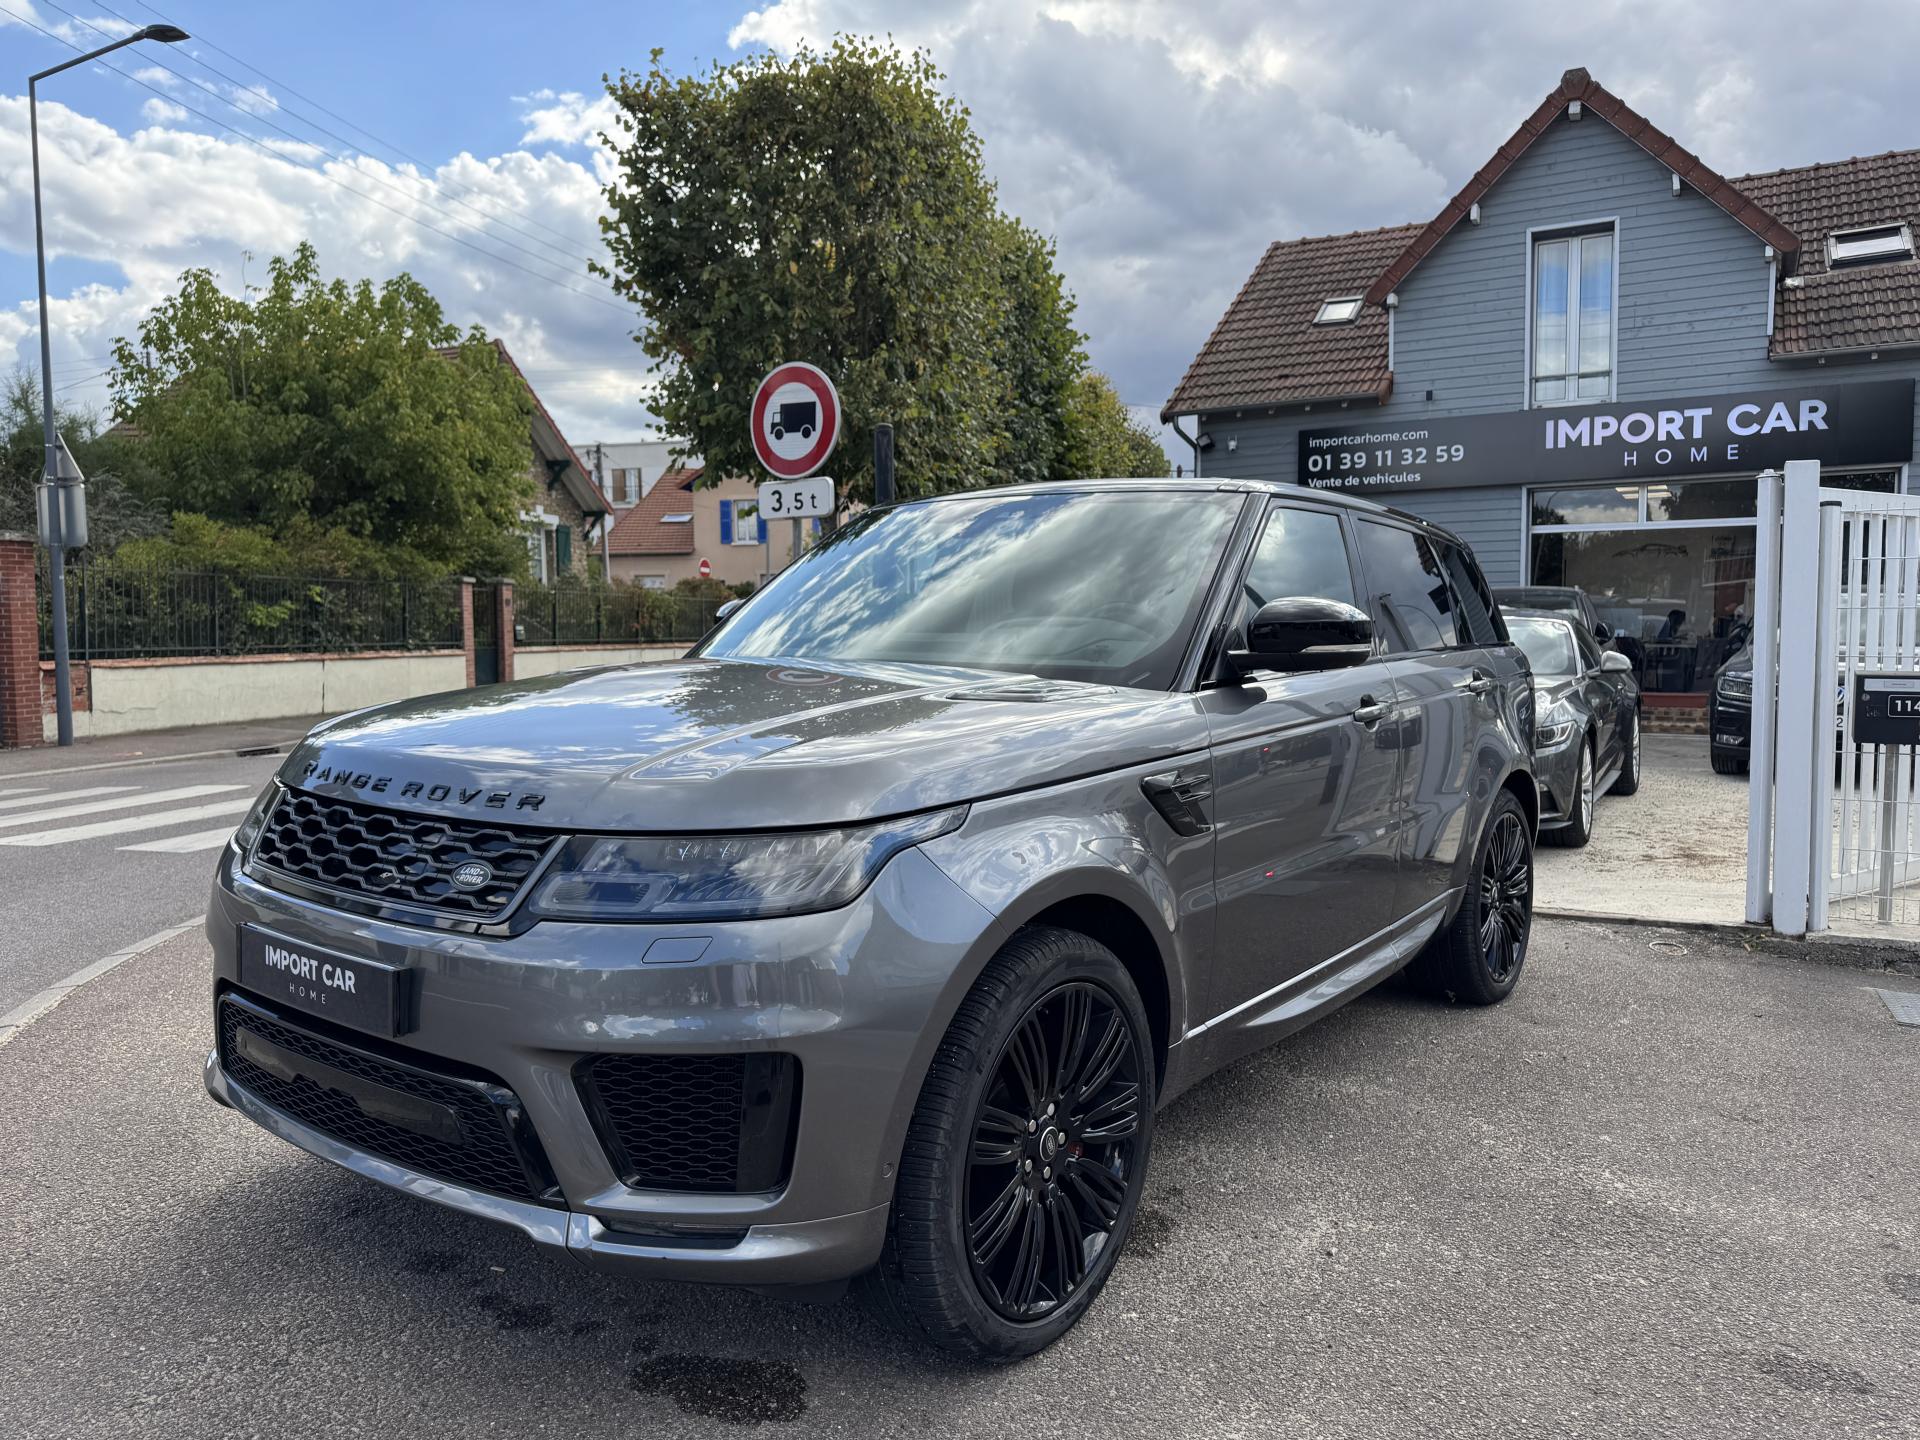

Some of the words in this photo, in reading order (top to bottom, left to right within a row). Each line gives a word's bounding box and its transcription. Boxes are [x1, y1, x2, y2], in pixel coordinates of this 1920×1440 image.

[1545, 407, 1713, 449] IMPORT
[1726, 399, 1829, 436] CAR
[1309, 430, 1429, 449] importcarhome.com
[1308, 454, 1332, 472] 01
[1339, 452, 1367, 469] 39
[1375, 449, 1393, 467] 11
[1401, 447, 1428, 465] 32
[1435, 444, 1465, 462] 59
[1624, 444, 1739, 467] HOME
[1308, 477, 1342, 488] Vente
[1344, 475, 1360, 486] de
[1363, 471, 1421, 485] vehicules
[771, 490, 804, 514] 3,5
[810, 493, 817, 509] t
[302, 760, 392, 793] RANGE
[400, 780, 546, 811] ROVER
[459, 874, 483, 884] ROVER
[460, 867, 481, 876] LAND
[265, 944, 318, 981] IMPORT
[322, 963, 356, 994] CAR
[289, 982, 326, 1004] HOME
